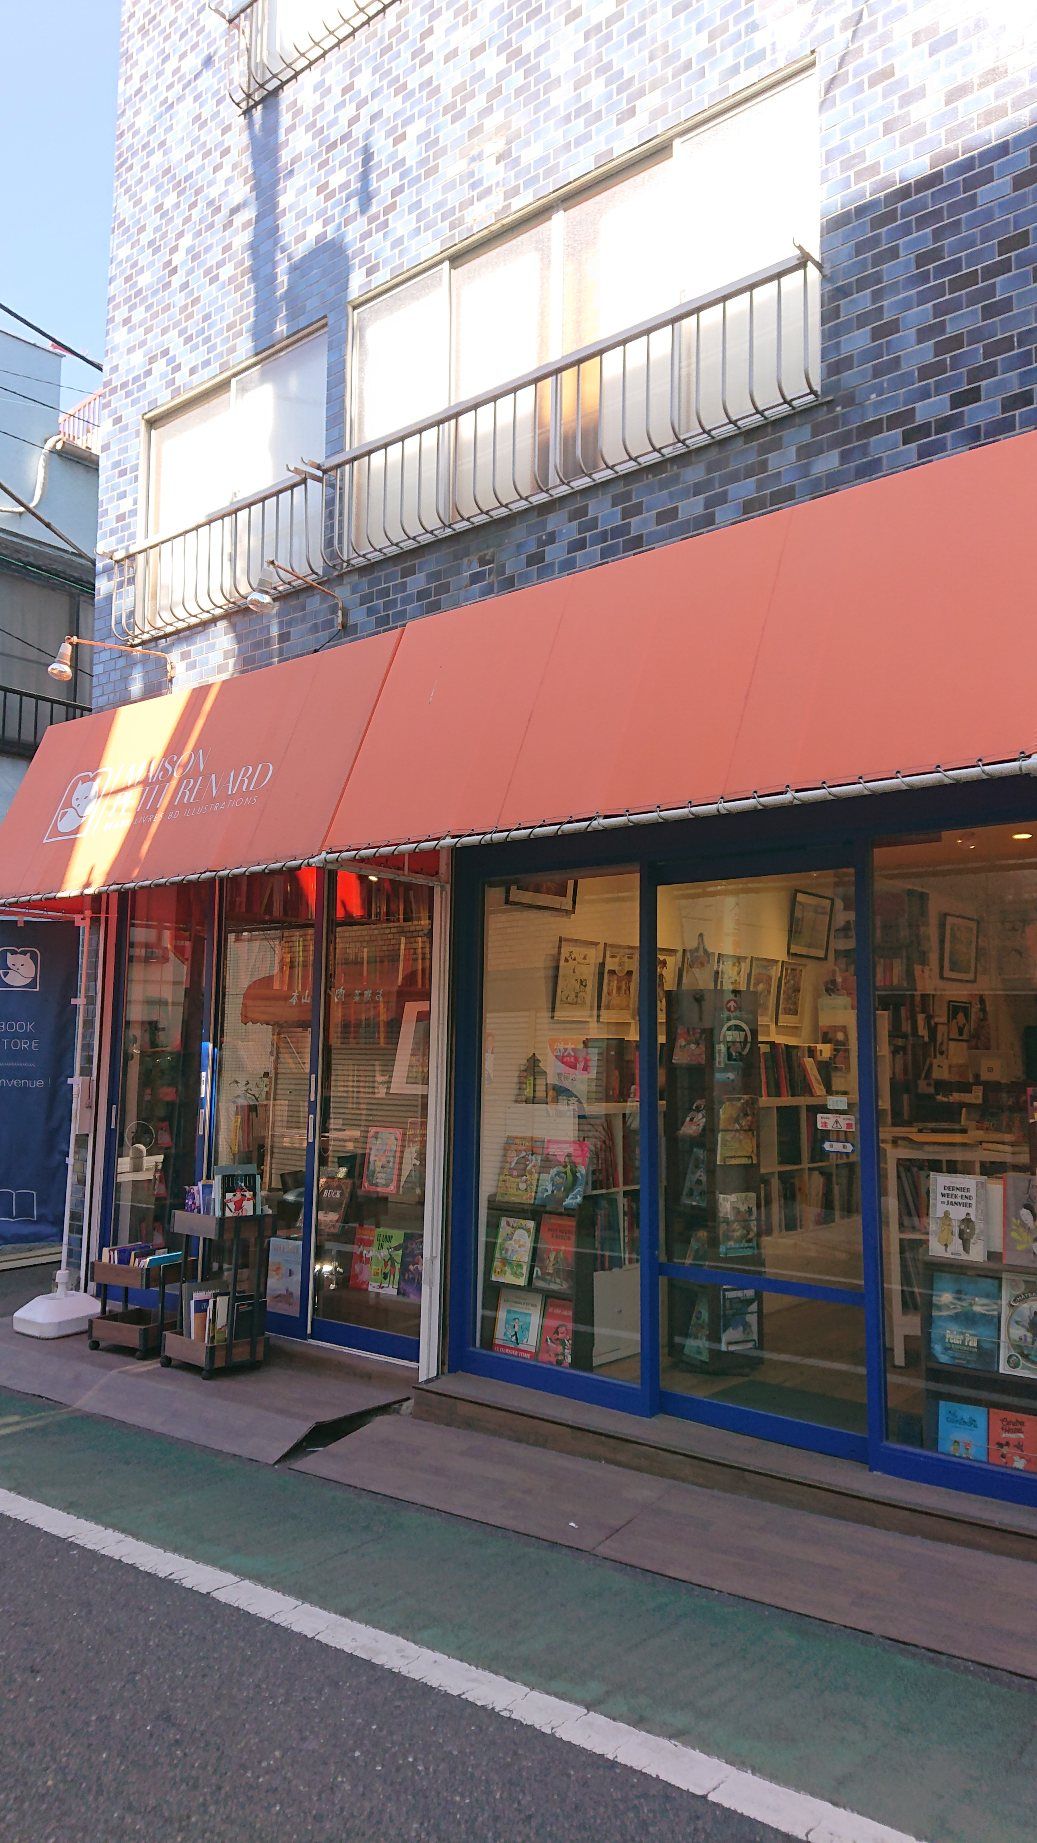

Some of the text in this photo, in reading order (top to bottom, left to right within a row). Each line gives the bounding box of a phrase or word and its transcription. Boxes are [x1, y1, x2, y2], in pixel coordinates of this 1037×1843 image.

[120, 747, 211, 787] MAISON
[175, 762, 273, 804] RENARD
[133, 811, 165, 825] LIVRES
[167, 810, 180, 820] BD
[184, 796, 258, 817] ILLUSTRATIONS
[323, 1189, 341, 1198] BUCK
[943, 1184, 971, 1194] DERNIER
[940, 1192, 974, 1201] WEEK-END
[946, 1200, 973, 1209] JANVIER
[945, 1329, 978, 1348] Peter Pan
